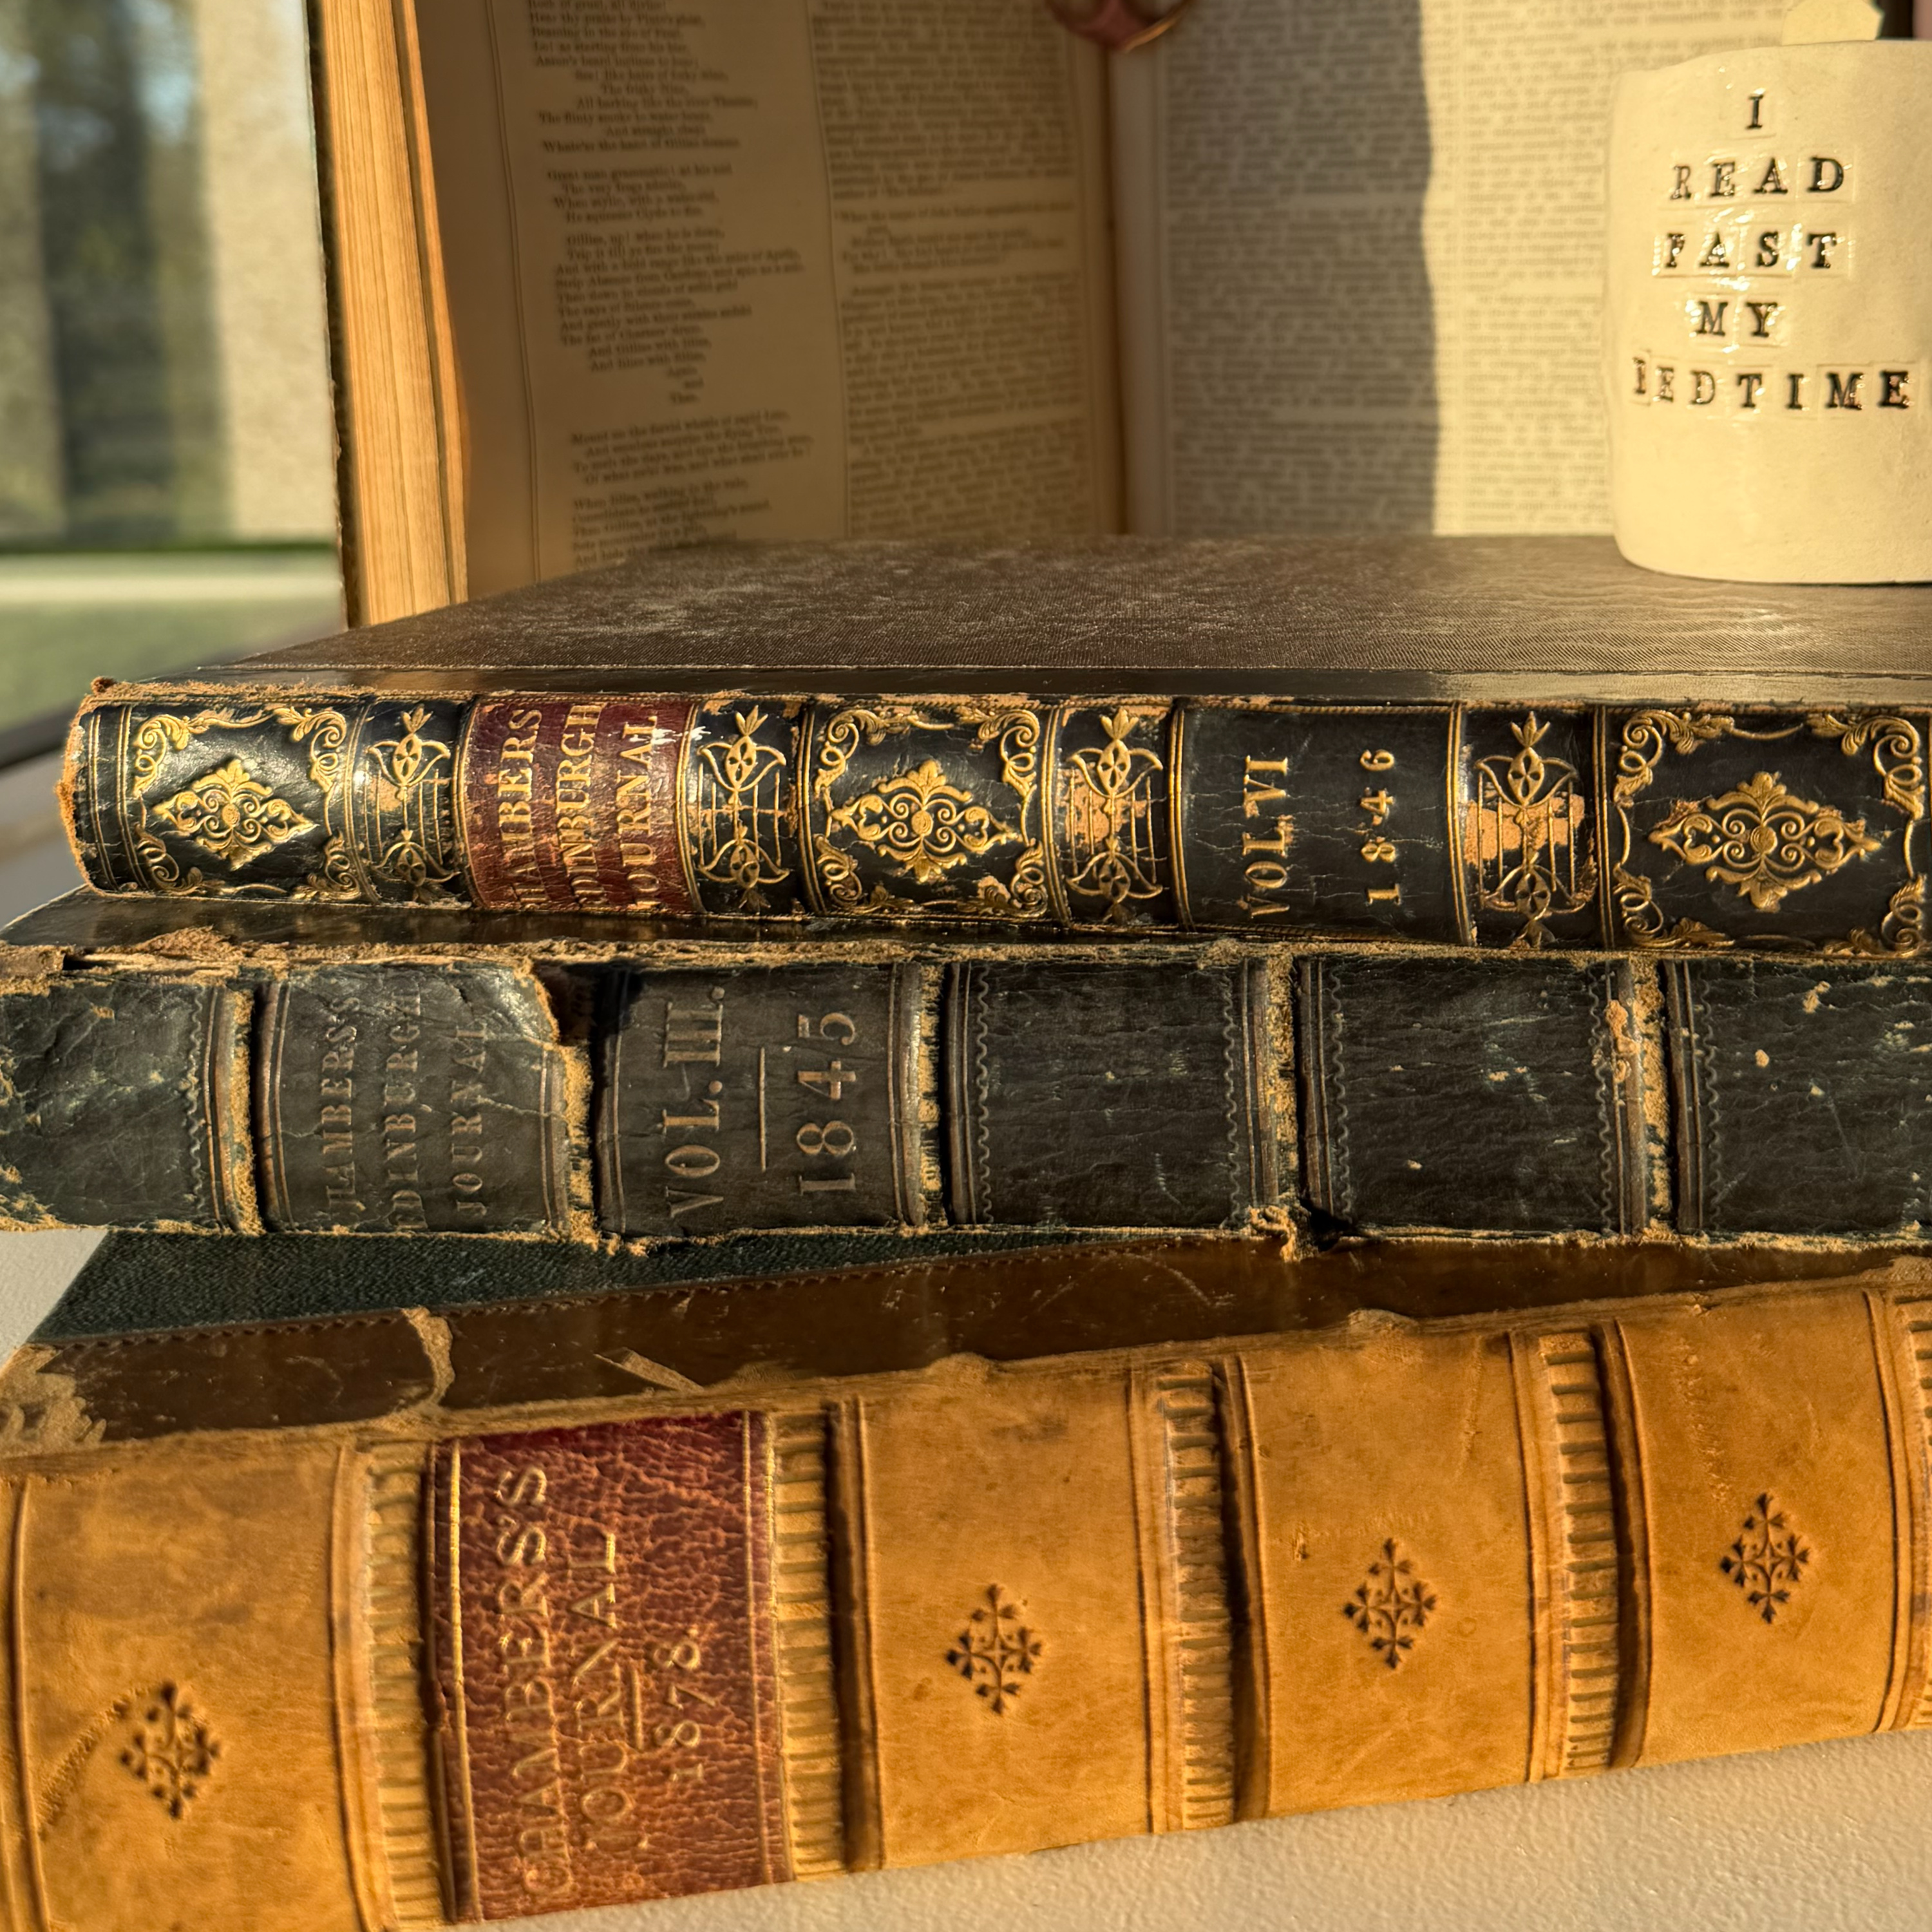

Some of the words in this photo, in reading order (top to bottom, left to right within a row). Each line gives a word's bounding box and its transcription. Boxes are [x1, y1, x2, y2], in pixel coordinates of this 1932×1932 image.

[1670, 157, 1845, 200] READ
[1745, 93, 1765, 129] I
[1697, 301, 1778, 337] MY
[616, 715, 661, 907] JOURNAL
[1358, 749, 1402, 907] 1846
[449, 1019, 488, 1217] JOURNAL
[658, 1080, 724, 1218] VOL.
[795, 1011, 857, 1197] 1845
[495, 1464, 573, 1895] CHAMBERS'S
[569, 1531, 647, 1853] JOURNAL
